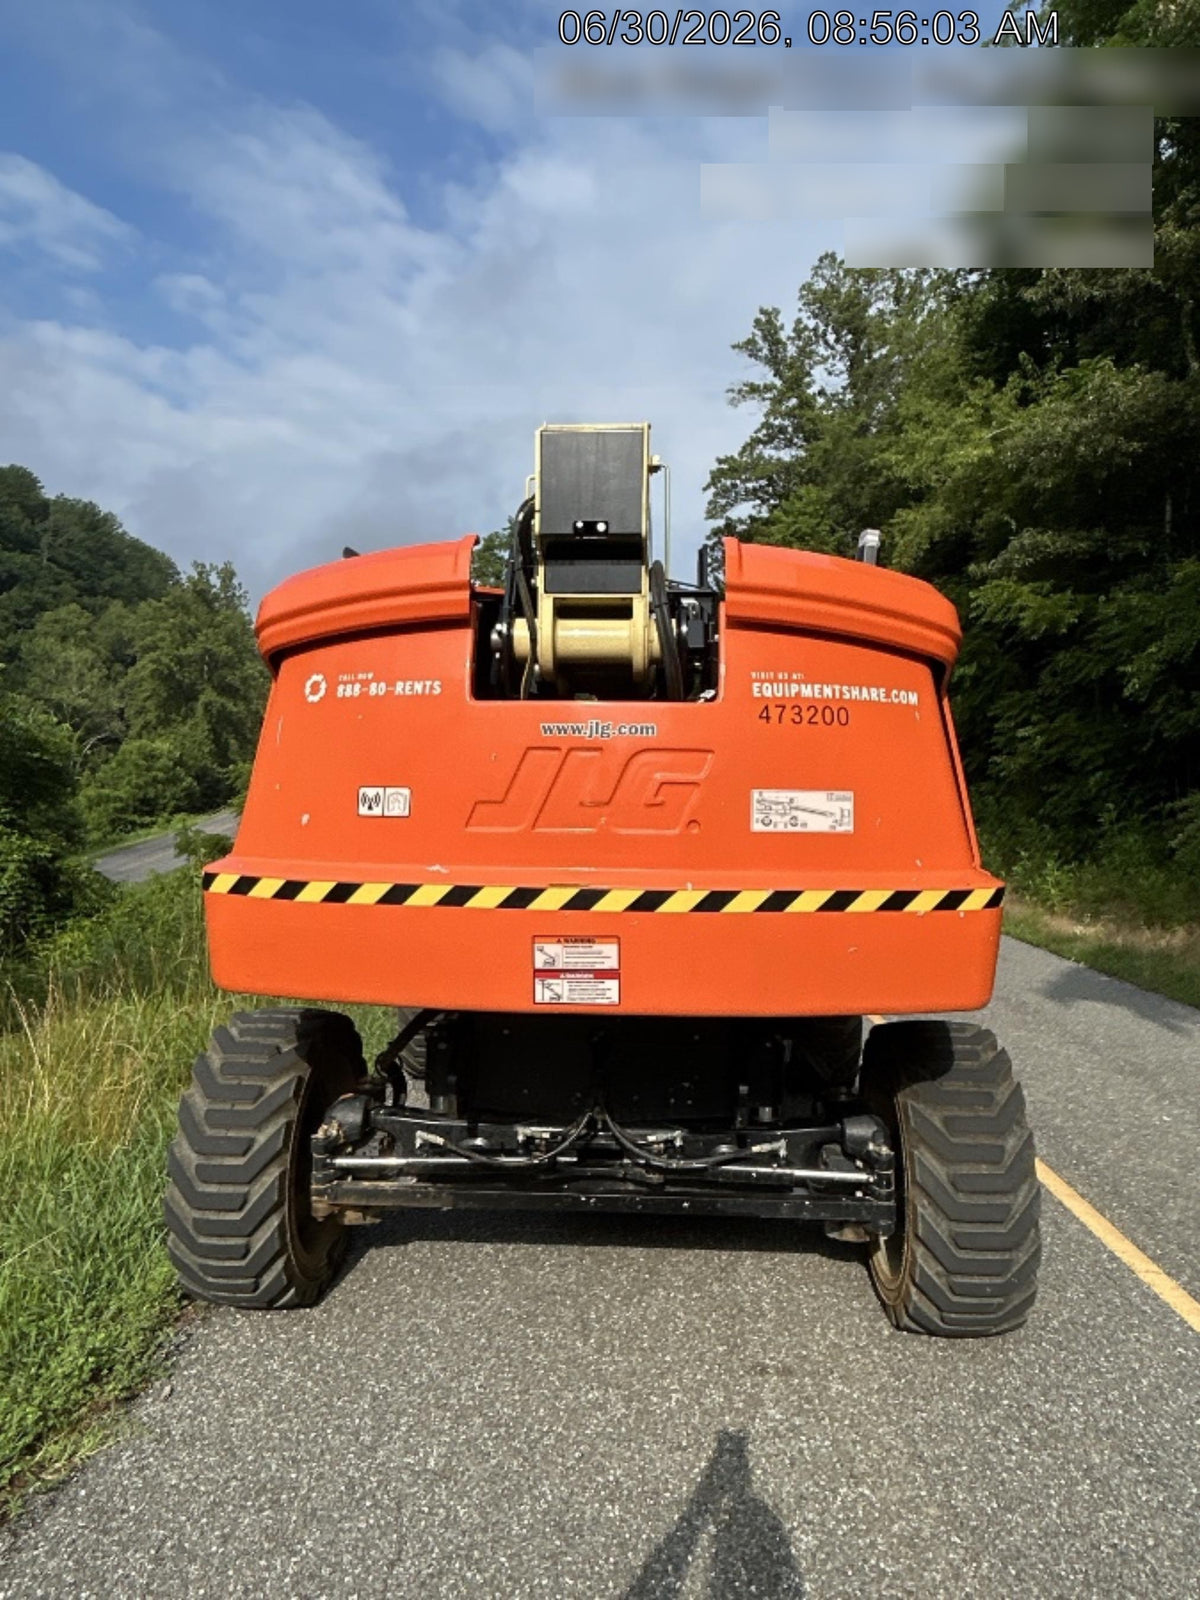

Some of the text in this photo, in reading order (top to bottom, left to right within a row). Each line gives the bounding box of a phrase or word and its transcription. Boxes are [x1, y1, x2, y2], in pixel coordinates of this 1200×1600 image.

[337, 681, 442, 698] 888-80-RENTS
[752, 682, 918, 706] EQUIPMENTSHARE.COM
[758, 704, 849, 726] 473200
[540, 720, 656, 739] www.jlg.com
